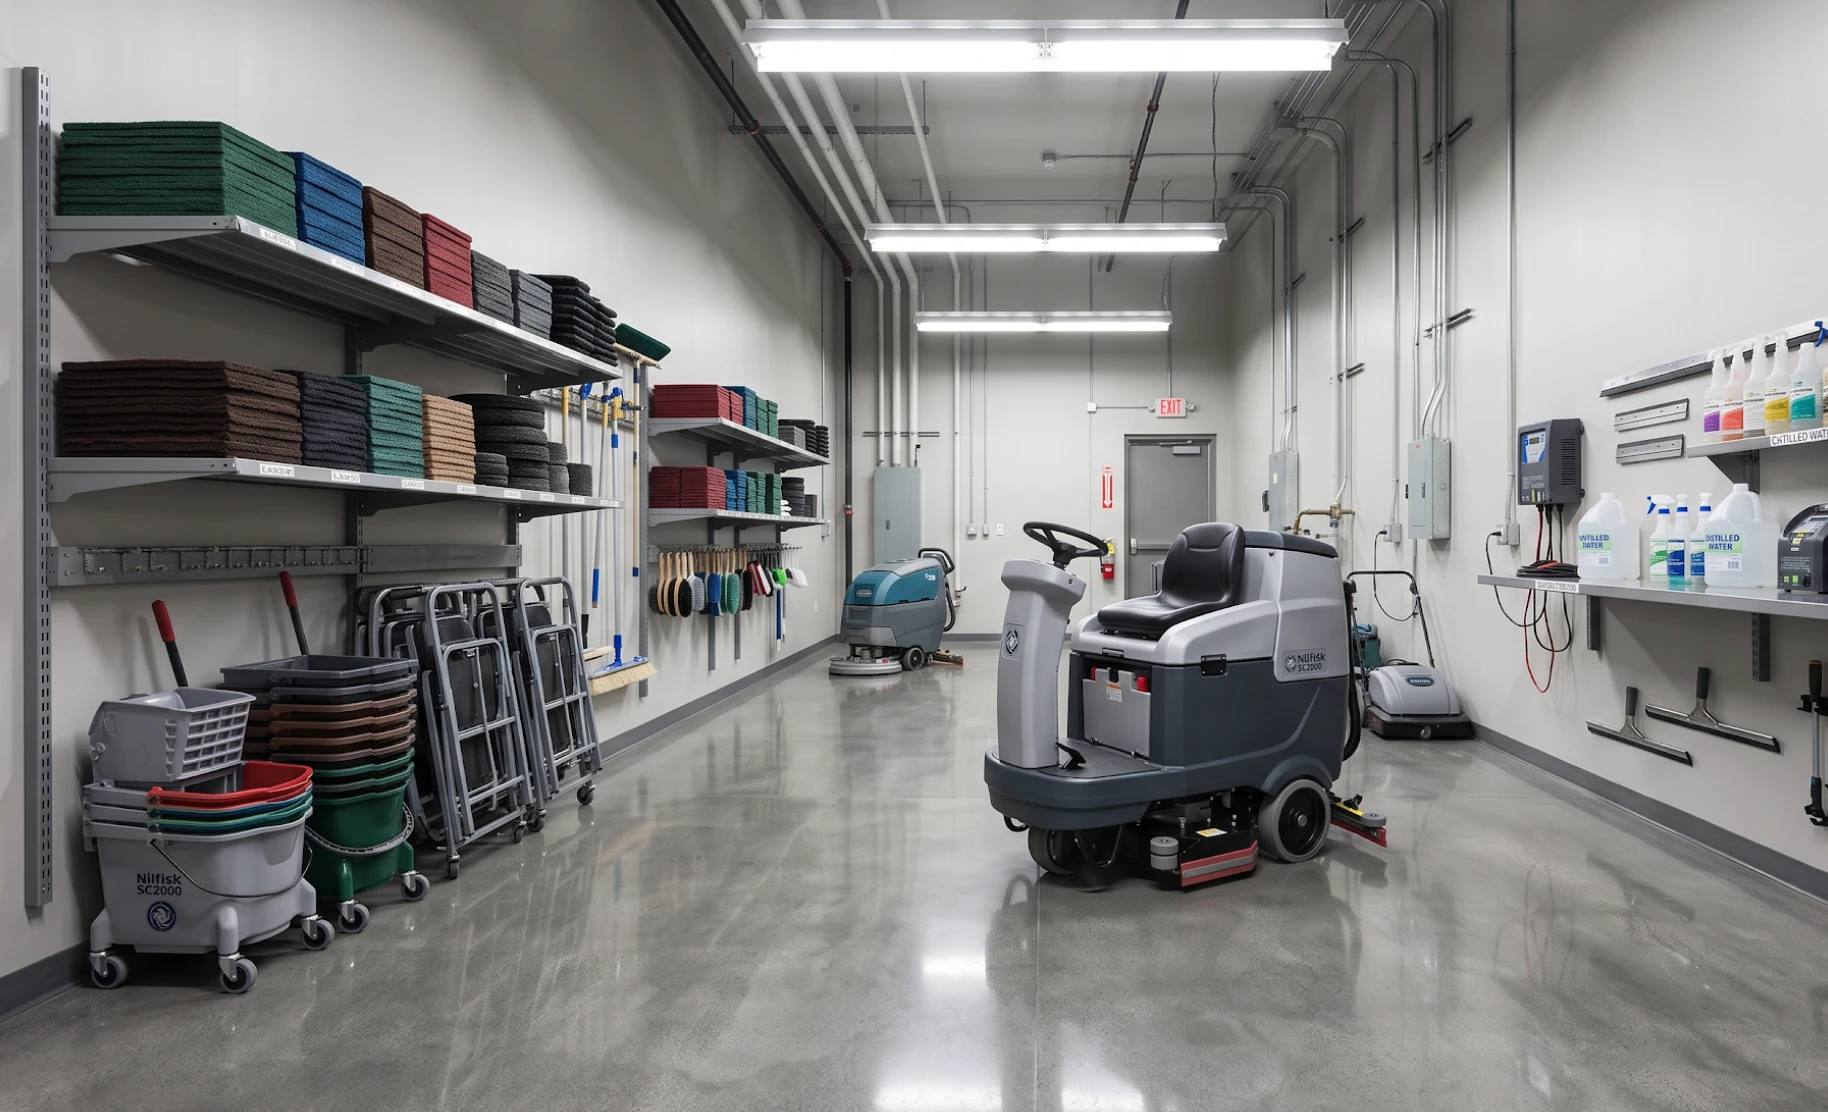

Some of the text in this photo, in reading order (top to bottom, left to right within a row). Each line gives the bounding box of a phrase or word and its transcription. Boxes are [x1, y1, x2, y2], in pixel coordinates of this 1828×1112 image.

[1160, 399, 1182, 414] EXIT
[1297, 662, 1322, 672] SC2000
[136, 872, 182, 885] Nilfisk
[136, 884, 183, 896] SC2000
